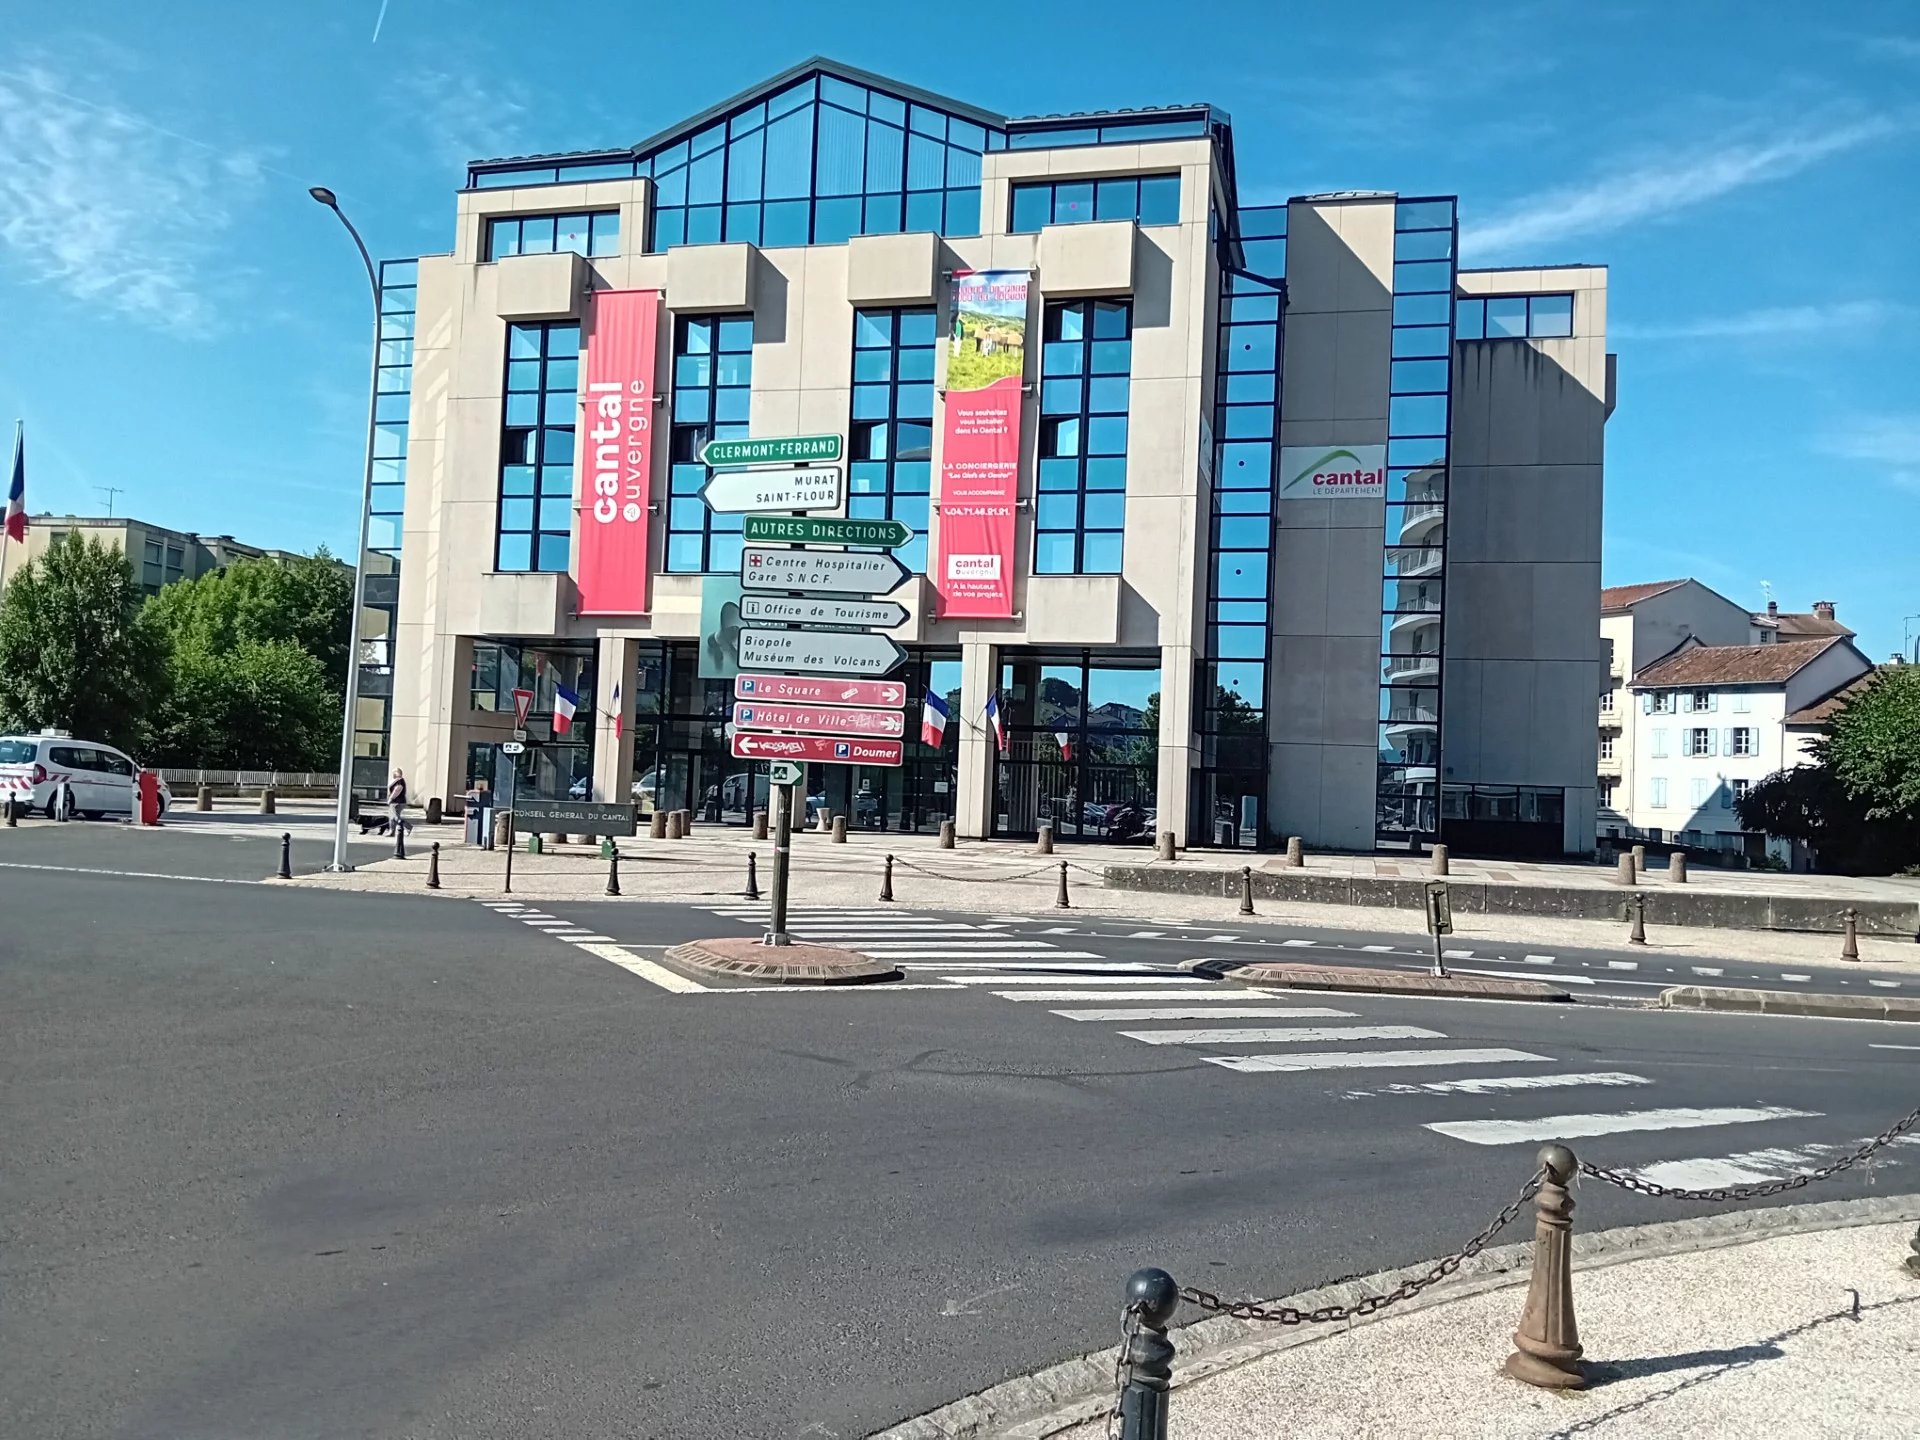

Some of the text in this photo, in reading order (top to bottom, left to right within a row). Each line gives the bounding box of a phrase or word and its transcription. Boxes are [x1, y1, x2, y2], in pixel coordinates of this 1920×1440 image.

[956, 409, 974, 417] Vous
[589, 382, 623, 524] cantal
[712, 440, 836, 459] CLERMONT-FERRAND
[955, 462, 1018, 470] CONCIERGERIE
[794, 474, 835, 486] MURAT
[1312, 468, 1383, 486] cantal
[756, 490, 834, 503] SAINT-FLOUR
[750, 522, 896, 539] AUTRES DIRECTIONS
[766, 556, 886, 571] Centre Hospitalier
[955, 557, 994, 568] cantal
[748, 572, 833, 585] Gare S.N.C.F.
[764, 603, 802, 615] Office
[810, 606, 825, 616] de
[835, 607, 889, 620] Tourisme
[745, 636, 792, 649] Biopole
[744, 651, 882, 668] Muséum des Volcans
[758, 682, 771, 693] Le
[778, 683, 822, 697] Square
[756, 711, 790, 724] Hôtel
[796, 713, 810, 725] de
[818, 714, 847, 727] Ville
[853, 746, 898, 760] Doumer
[514, 809, 630, 821] CONSEIL GENERAL DU CANTAL
